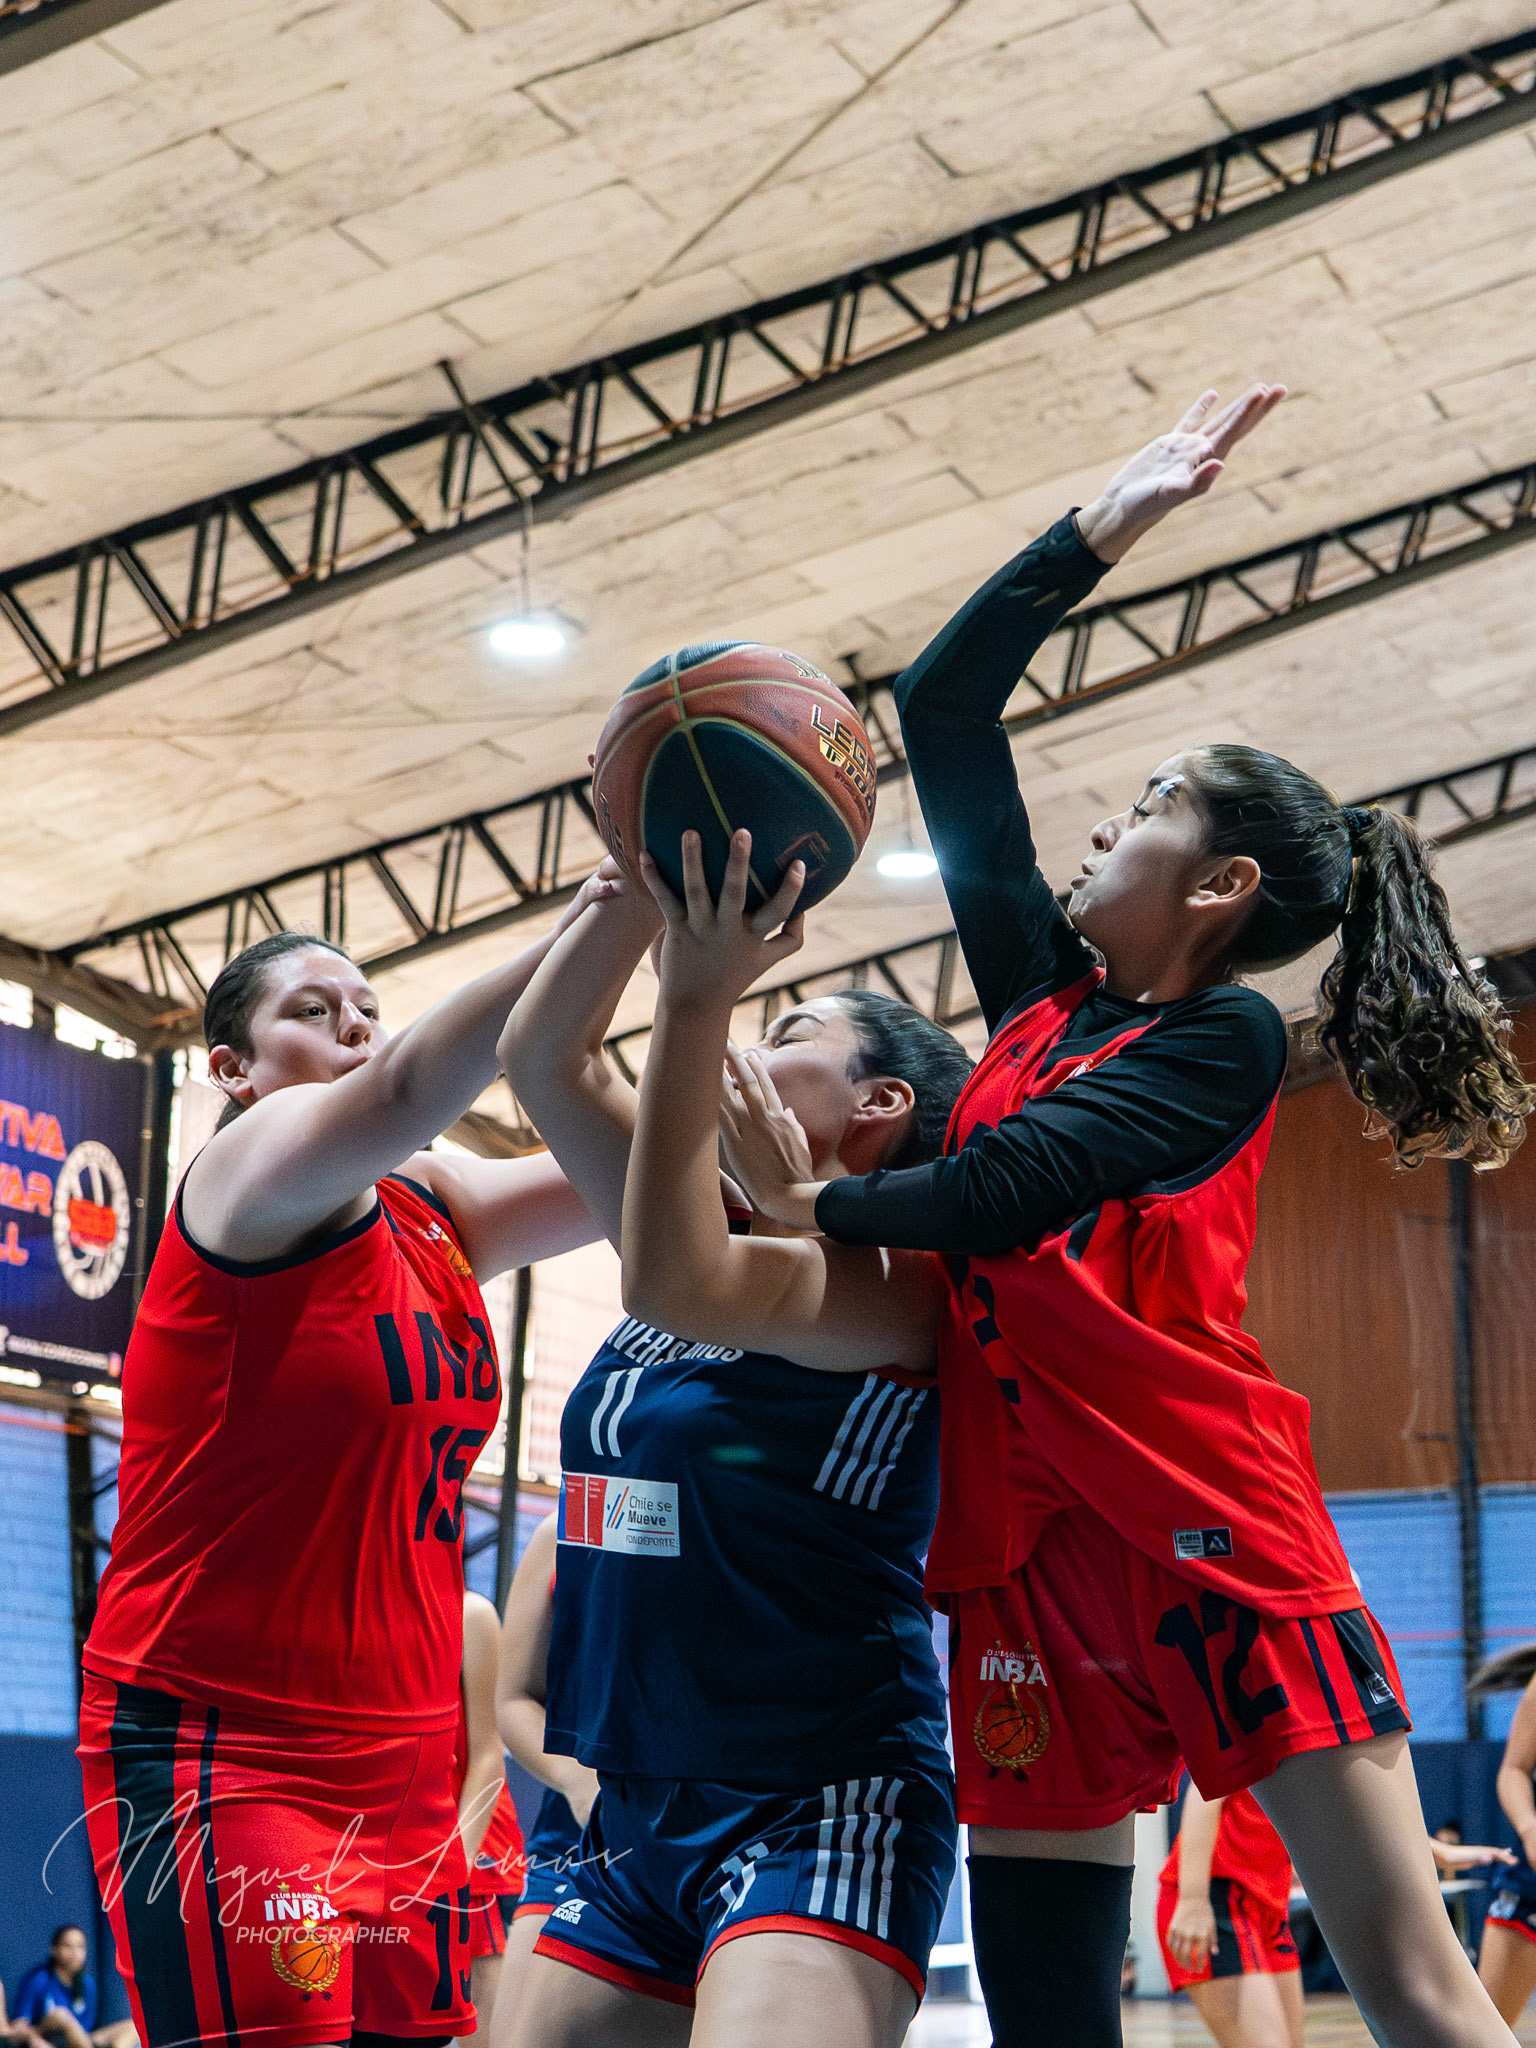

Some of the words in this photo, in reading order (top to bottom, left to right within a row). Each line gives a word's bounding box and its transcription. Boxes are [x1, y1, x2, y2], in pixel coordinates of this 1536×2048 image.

[590, 1367, 644, 1457] 11
[414, 1425, 489, 1542] 15
[627, 1510, 667, 1527] Mueve
[629, 1495, 654, 1511] Chile
[657, 1501, 672, 1513] se
[979, 1656, 1048, 1687] INBA
[1154, 1590, 1290, 1750] 12
[264, 1899, 339, 1922] INBA
